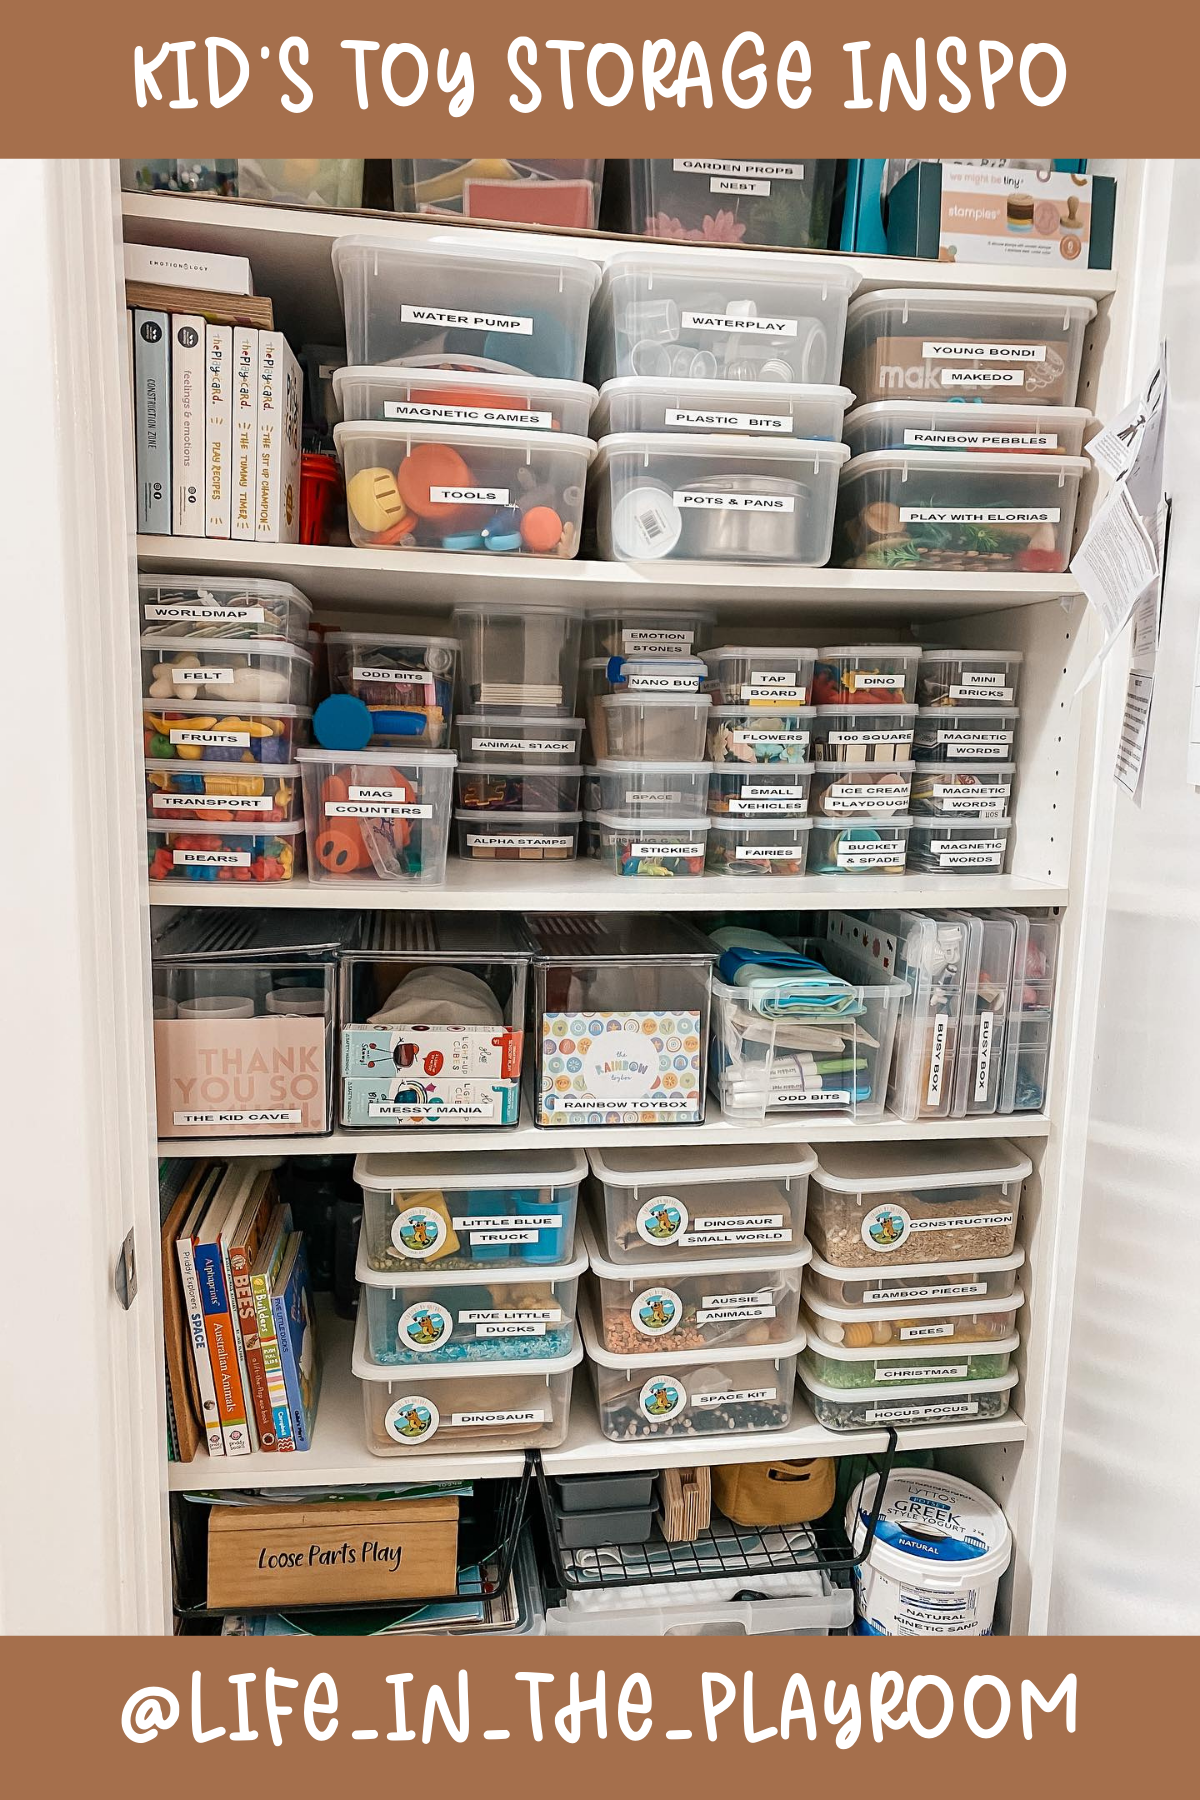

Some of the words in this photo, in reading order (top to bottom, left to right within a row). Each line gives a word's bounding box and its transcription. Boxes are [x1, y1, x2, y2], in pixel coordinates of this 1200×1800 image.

[683, 160, 741, 172] GARDEN
[746, 165, 793, 175] PROPS
[720, 181, 756, 191] NEST
[964, 173, 989, 186] might
[412, 311, 470, 326] WATER
[474, 317, 521, 329] PUMP
[692, 316, 786, 331] WATERPLAY
[933, 346, 984, 356] YOUNG
[989, 347, 1036, 357] BONDI
[951, 373, 1013, 382] MAKEDO
[183, 370, 193, 410] feelings
[147, 378, 157, 431] CONSTRUCTION
[395, 406, 480, 420] MAGNETIC
[484, 412, 540, 424] GAMES
[676, 413, 738, 425] PLASTIC
[749, 418, 782, 427] BITS
[147, 432, 157, 450] ZONE
[240, 432, 248, 450] THE
[262, 433, 270, 449] THE
[914, 433, 979, 443] RAINBOW
[983, 436, 1047, 445] PEBBLES
[212, 442, 221, 463] PLAY
[262, 453, 270, 466] SIT
[239, 455, 248, 487] TUMMY
[212, 465, 221, 500] RECIPES
[259, 479, 270, 524] CHAMPION
[442, 491, 497, 501] TOOLS
[684, 496, 723, 505] POTS
[728, 497, 739, 505] &
[744, 498, 784, 508] PANS
[237, 491, 247, 520] TIMER
[910, 513, 948, 521] PLAY
[951, 513, 985, 521] WITH
[988, 513, 1048, 521] ELORIAS
[155, 608, 247, 618] WORLDMAP
[631, 632, 685, 640] EMOTION
[633, 645, 682, 653] STONES
[183, 672, 222, 680] FELT
[362, 671, 391, 679] ODD
[394, 673, 424, 681] BITS
[631, 678, 669, 687] NANO
[959, 689, 1004, 697] BRICKS
[181, 733, 238, 743] FRUITS
[479, 741, 525, 749] ANIMAL
[529, 742, 569, 750] STACK
[359, 790, 393, 798] MAG
[163, 797, 262, 807] TRANSPORT
[336, 806, 422, 815] COUNTERS
[940, 842, 1002, 850] MAGNETIC
[185, 854, 238, 863] BEARS
[934, 1024, 944, 1060] BUSY
[981, 1021, 989, 1057] BUSY
[198, 1046, 320, 1075] THANK
[595, 1060, 648, 1075] RAINBOW
[931, 1064, 939, 1092] BOX
[978, 1061, 986, 1088] BOX
[173, 1077, 251, 1102] YOU
[269, 1074, 320, 1101] SO
[248, 1113, 289, 1121] CAVE
[462, 1218, 510, 1227] LITTLE
[513, 1217, 553, 1226] BLUE
[703, 1217, 773, 1227] DINOSAUR
[909, 1215, 1013, 1229] CONSTRUCTION
[480, 1233, 529, 1241] TRUCK
[687, 1235, 732, 1243] SMALL
[738, 1232, 783, 1241] WORLD
[183, 1251, 192, 1275] Priddy
[186, 1276, 198, 1310] Explorers
[234, 1275, 254, 1319] BEES
[872, 1288, 928, 1299] BAMBOO
[932, 1286, 978, 1295] PIECES
[711, 1295, 759, 1304] AUSSIE
[256, 1293, 270, 1332] Builders
[468, 1312, 500, 1320] FIVE
[705, 1309, 763, 1319] ANIMALS
[191, 1313, 206, 1349] SPACE
[486, 1325, 536, 1333] DUCKS
[909, 1328, 944, 1336] BEES
[280, 1332, 289, 1353] DUCKS
[213, 1322, 229, 1372] Australian
[221, 1373, 235, 1413] Animals
[883, 1368, 958, 1377] CHRISTMAS
[700, 1393, 743, 1403] SPACE
[747, 1391, 767, 1399] KIT
[461, 1413, 535, 1422] DINOSAUR
[874, 1409, 920, 1418] HOCUS
[924, 1405, 969, 1414] POCUS
[908, 1486, 957, 1504] LYTTOS
[894, 1500, 961, 1526] GREEK
[887, 1508, 918, 1520] STYLE
[922, 1516, 967, 1533] YOGURT
[898, 1538, 940, 1555] NATURAL
[258, 1544, 304, 1572] Loose
[308, 1544, 358, 1568] Parts
[362, 1541, 403, 1571] Play
[906, 1608, 966, 1621] NATURAL
[893, 1615, 943, 1632] KINETIC
[947, 1621, 979, 1632] SAND
